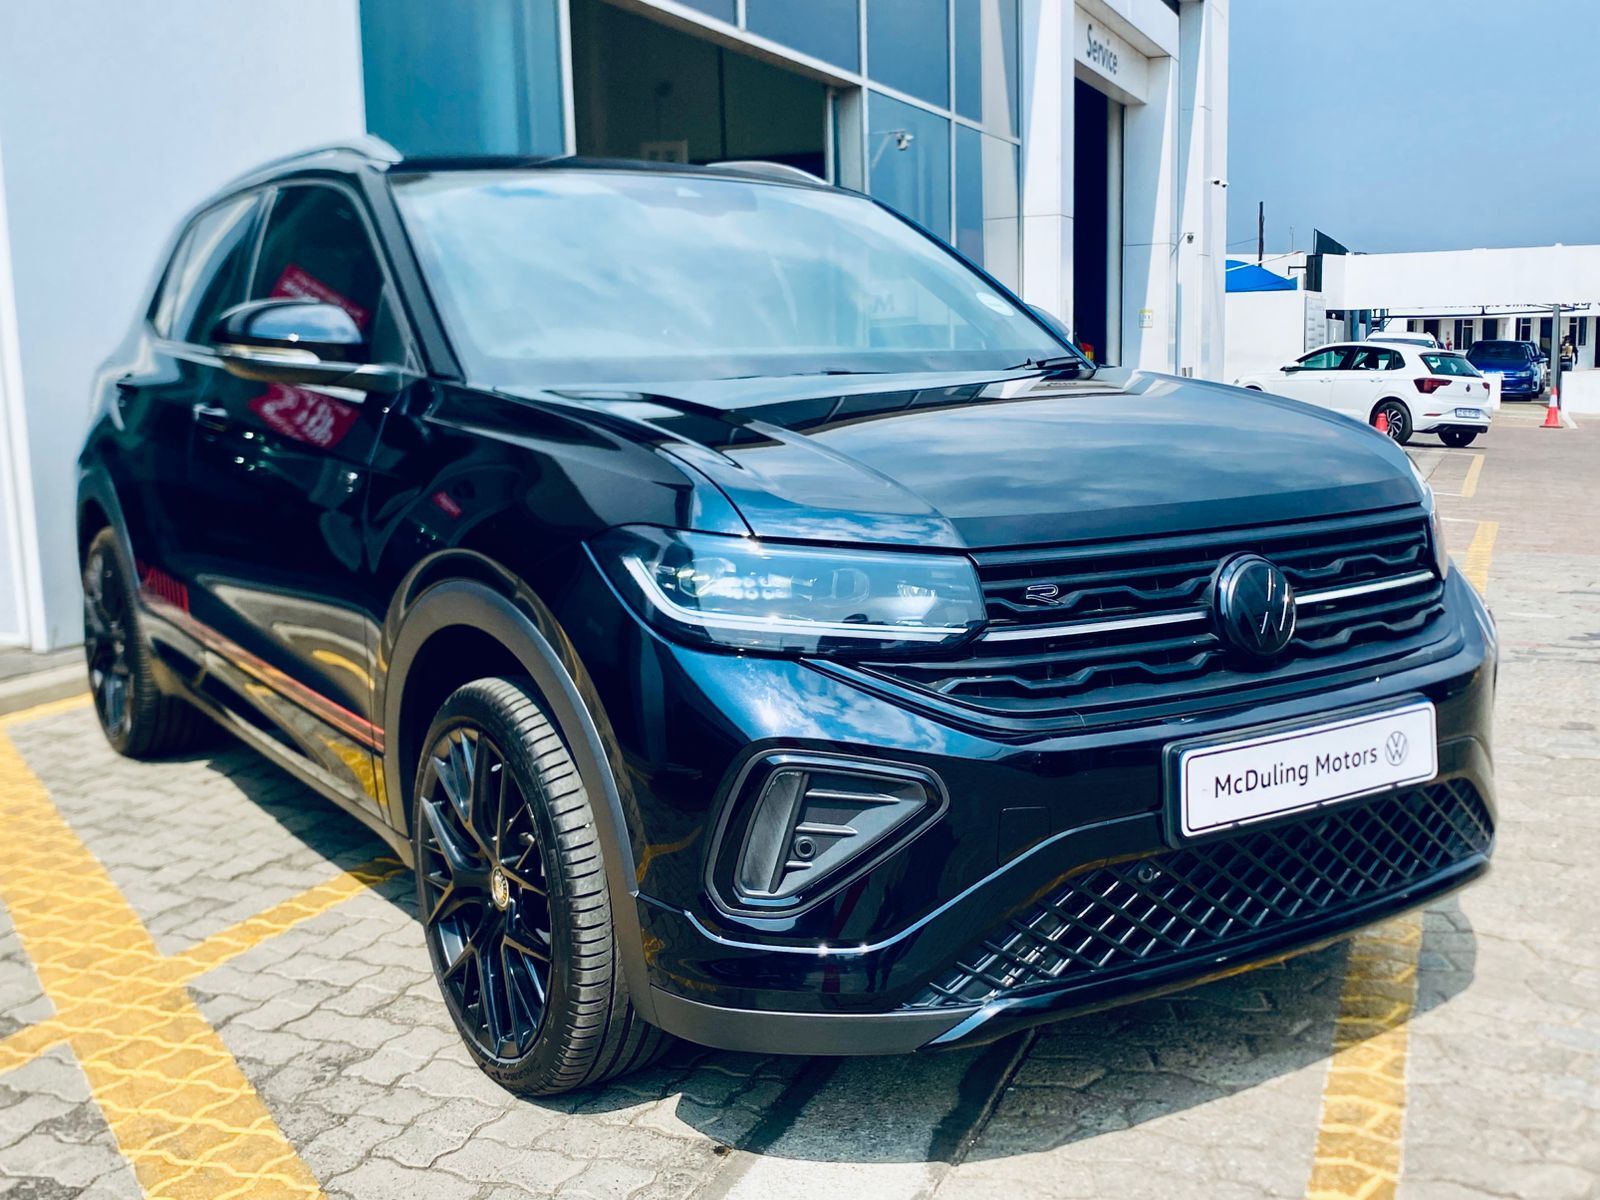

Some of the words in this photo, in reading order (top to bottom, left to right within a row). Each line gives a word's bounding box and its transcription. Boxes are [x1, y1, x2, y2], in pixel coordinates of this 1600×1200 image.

[1086, 23, 1118, 75] Service
[1214, 762, 1309, 798] McDuling
[1315, 746, 1378, 777] Motors
